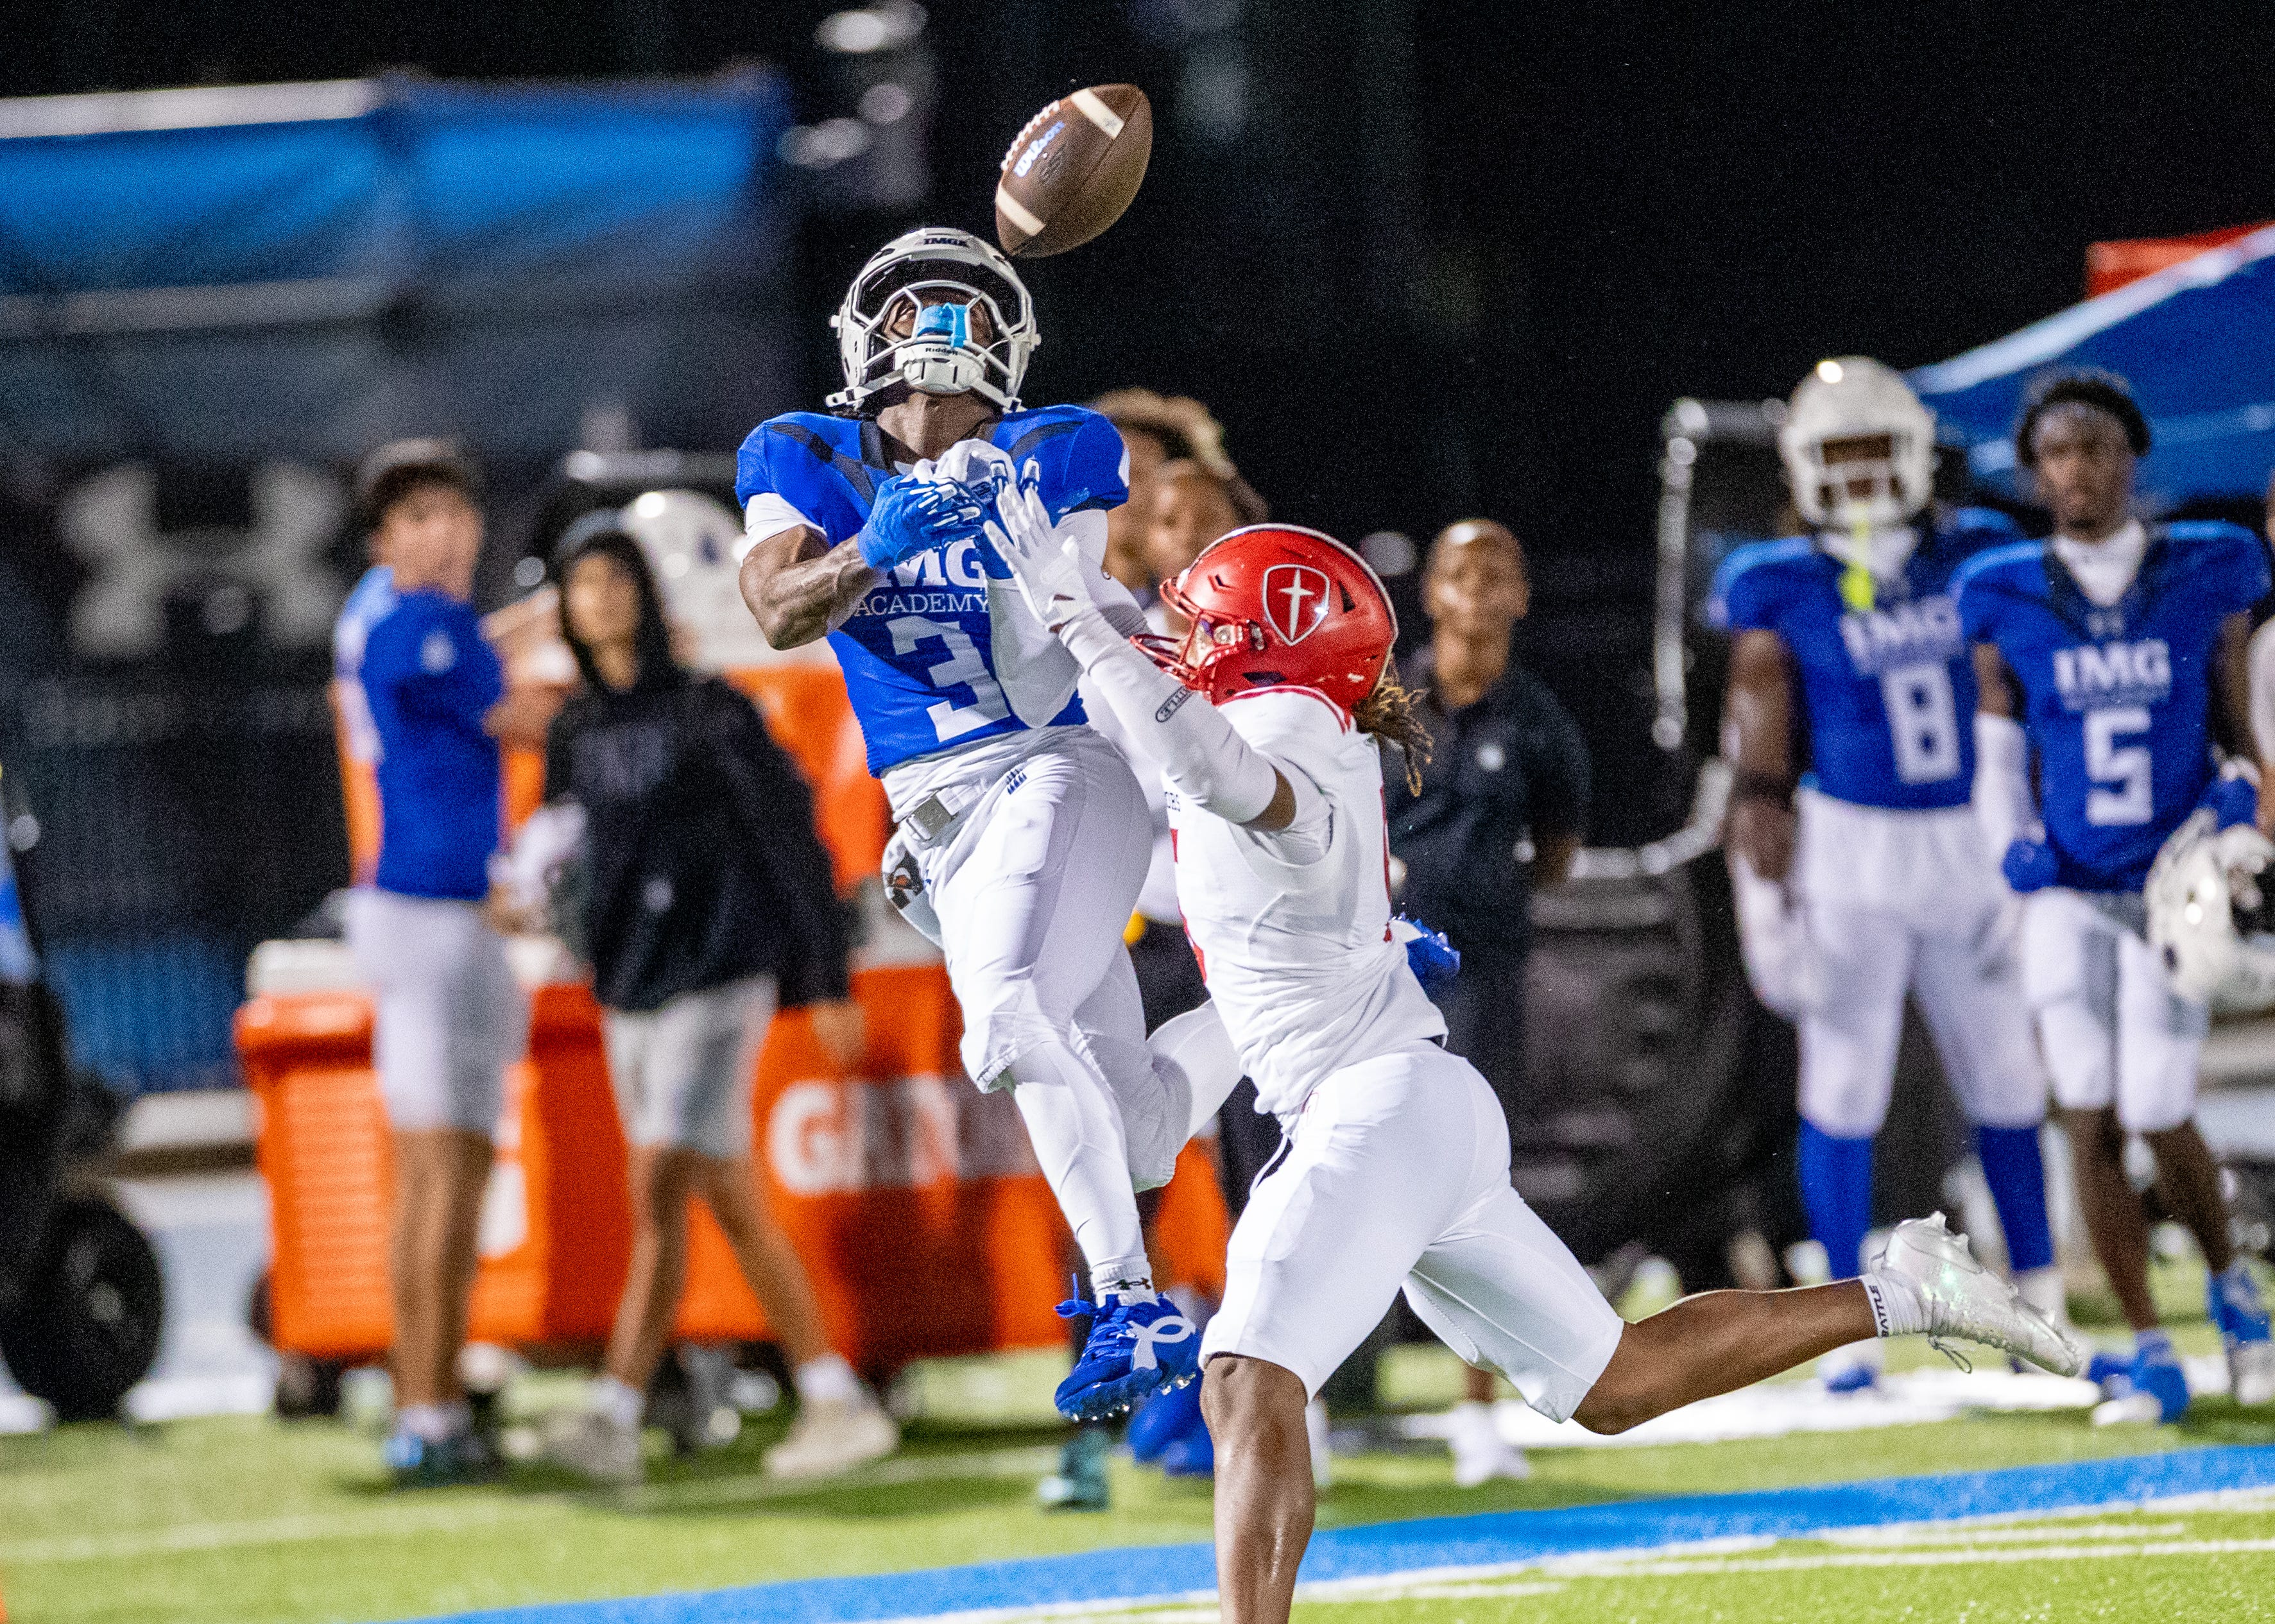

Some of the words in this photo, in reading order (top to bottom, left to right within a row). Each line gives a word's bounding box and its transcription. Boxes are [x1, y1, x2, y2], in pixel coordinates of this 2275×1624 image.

[882, 538, 986, 588] MG
[853, 593, 990, 617] ACADEMY
[886, 615, 1011, 742] 3
[2054, 639, 2172, 696] IMG
[1880, 662, 1960, 784] 8
[2084, 709, 2152, 825] 5
[1869, 1285, 1889, 1338] BATTLE
